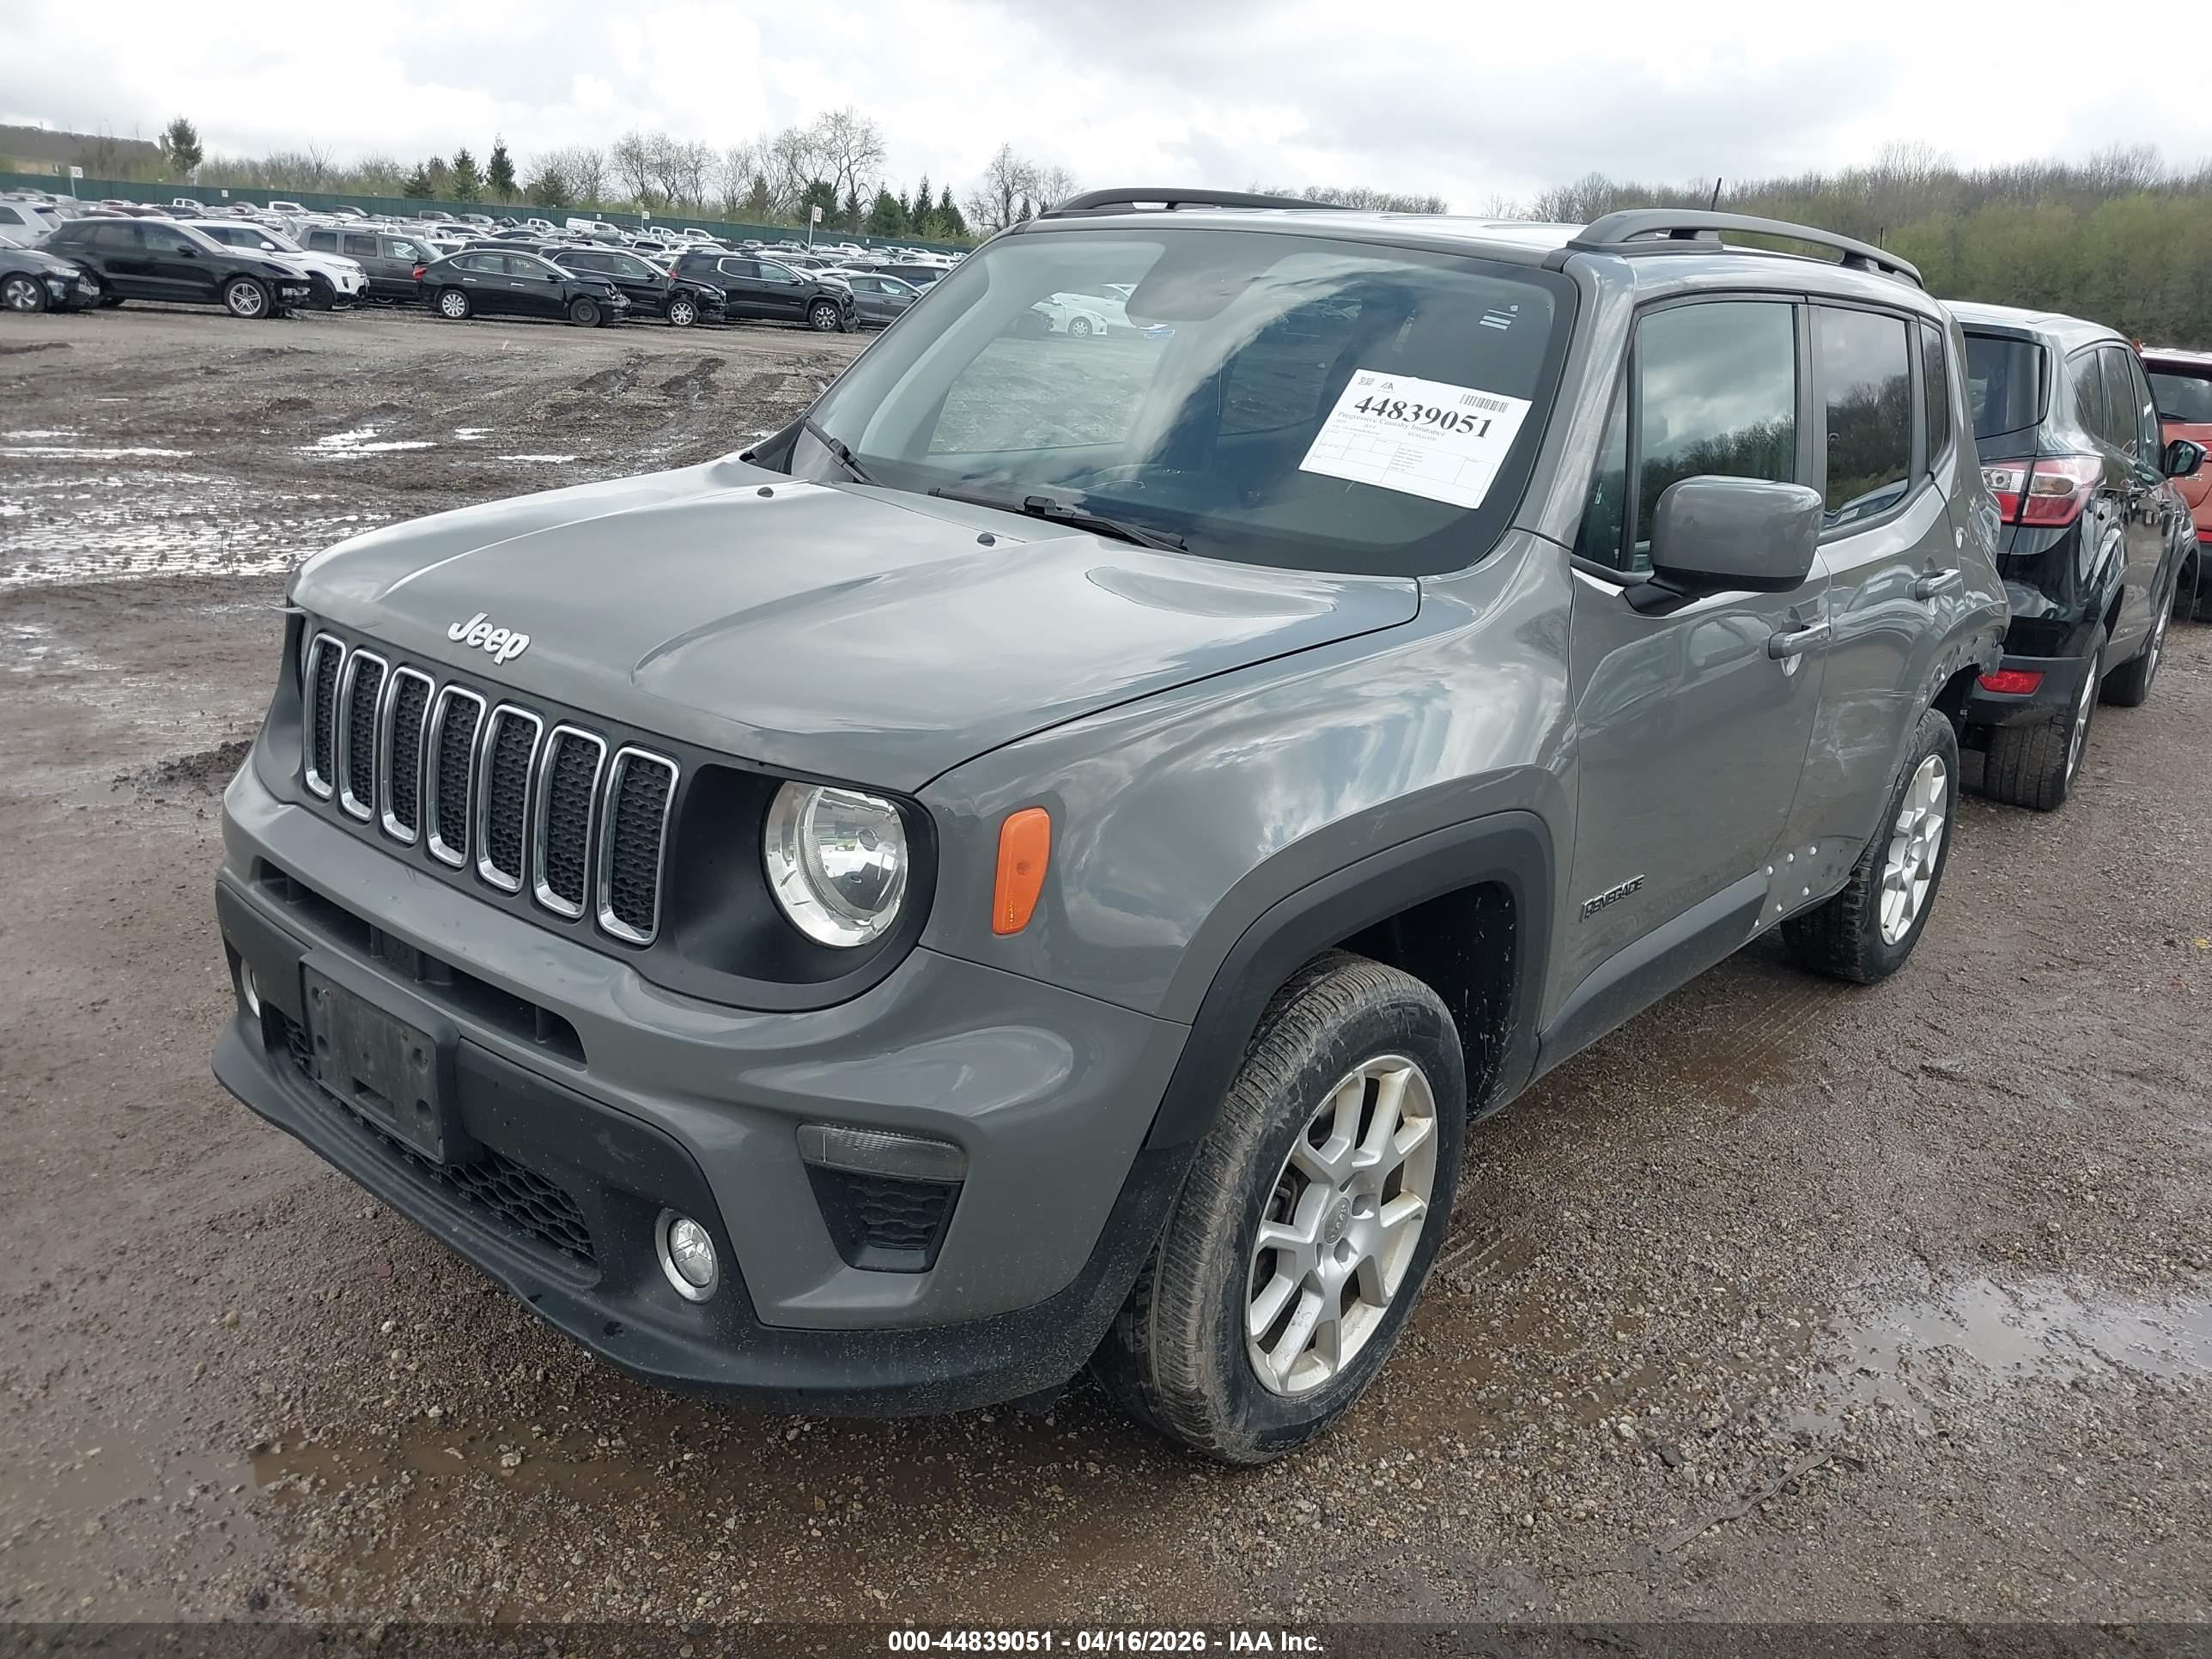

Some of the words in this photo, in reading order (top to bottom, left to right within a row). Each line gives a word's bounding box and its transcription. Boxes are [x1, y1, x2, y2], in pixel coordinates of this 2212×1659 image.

[1354, 395, 1493, 439] 44839051
[1411, 423, 1446, 437] Insurance
[447, 611, 531, 665] Jeep
[1579, 873, 1645, 922] RENEGADE
